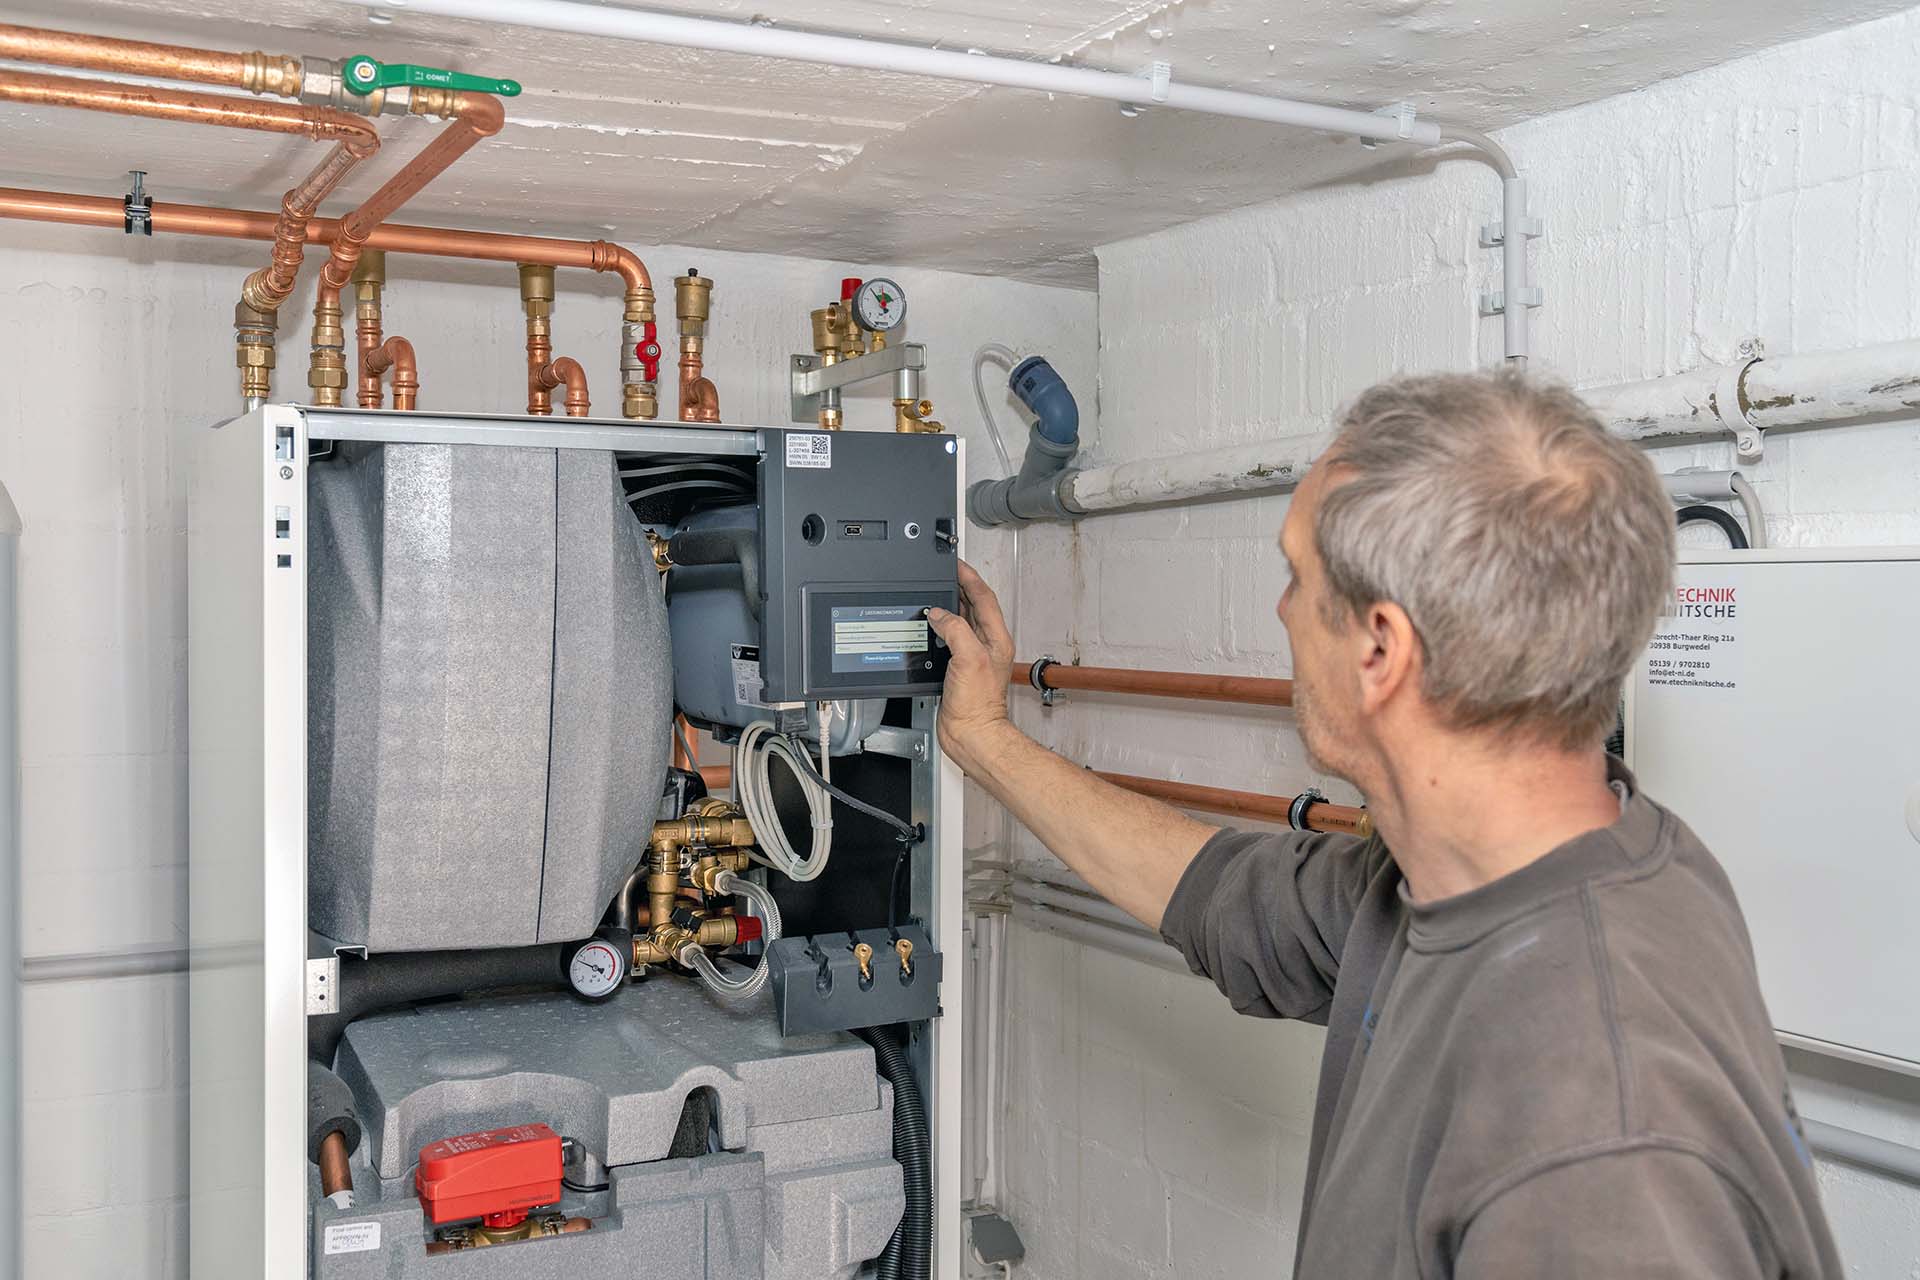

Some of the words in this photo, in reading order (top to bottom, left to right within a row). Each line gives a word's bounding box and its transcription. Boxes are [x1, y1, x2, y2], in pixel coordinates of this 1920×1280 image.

[426, 73, 450, 82] COMET
[1676, 588, 1736, 602] ECHNIK
[1702, 634, 1719, 643] Ring
[1721, 634, 1735, 642] 21a
[1672, 642, 1710, 651] Burgwedel
[1649, 659, 1671, 667] 05139
[1679, 661, 1711, 669] 9702810
[1649, 679, 1736, 688] www.etechniknitsche.de
